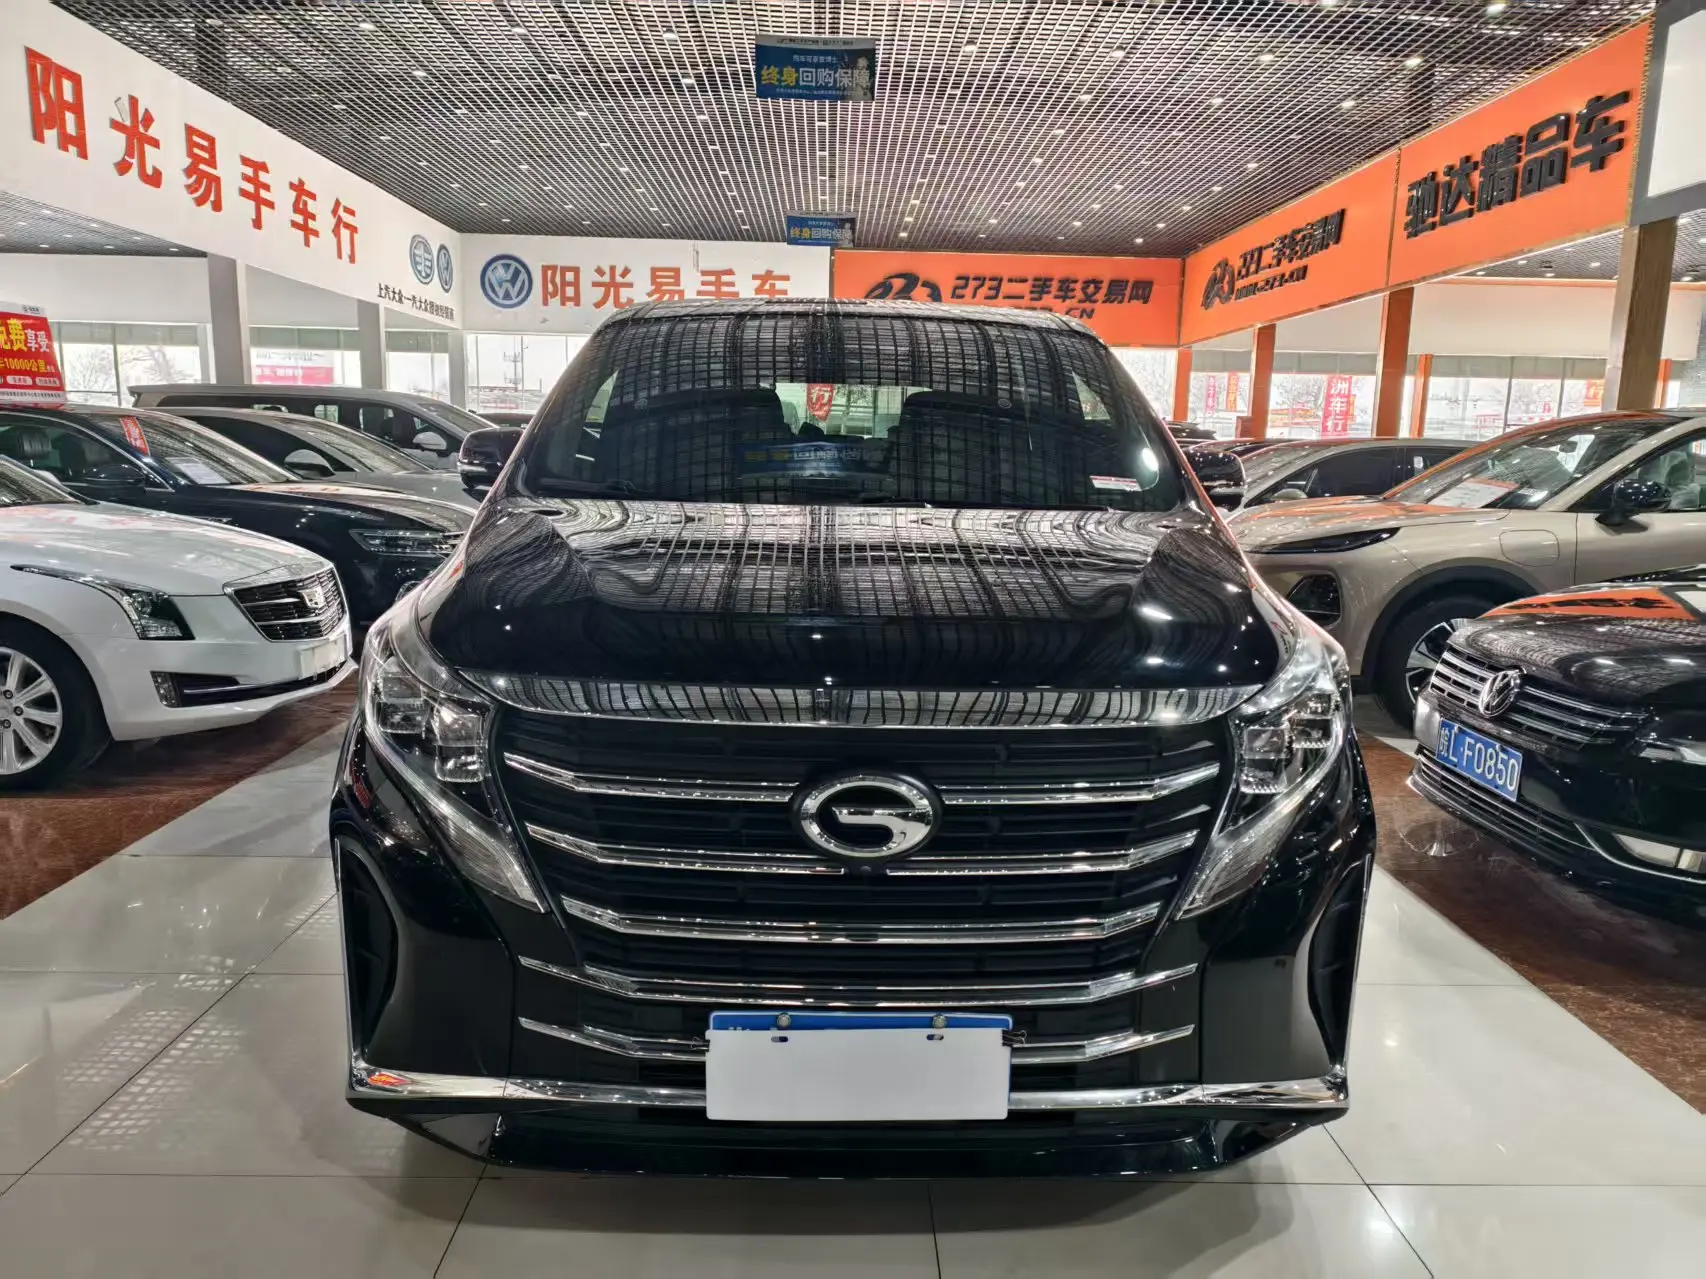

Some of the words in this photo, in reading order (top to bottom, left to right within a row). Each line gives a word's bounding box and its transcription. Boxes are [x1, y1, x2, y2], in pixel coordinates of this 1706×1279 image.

[761, 65, 870, 87] 终身回购保障
[25, 46, 359, 265] 阳光易手车行
[950, 275, 1154, 304] 273二手车交易网
